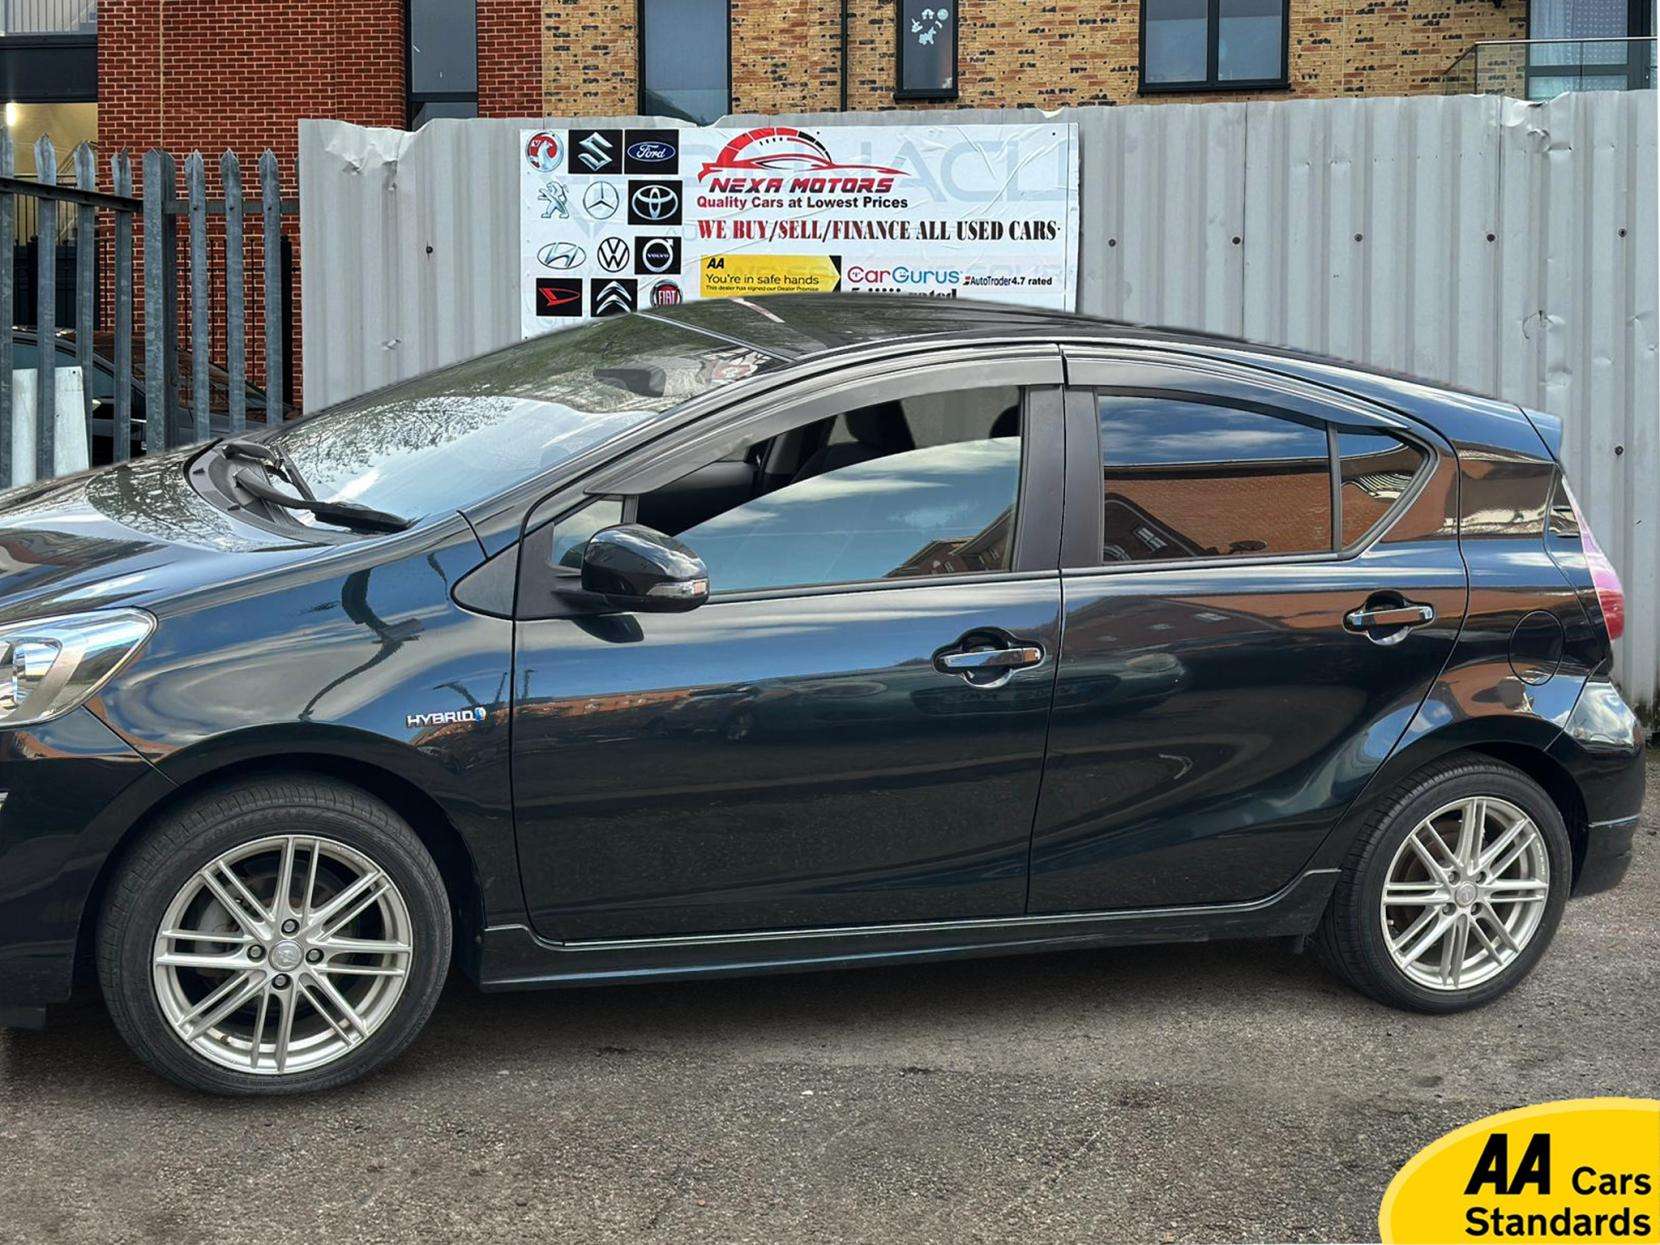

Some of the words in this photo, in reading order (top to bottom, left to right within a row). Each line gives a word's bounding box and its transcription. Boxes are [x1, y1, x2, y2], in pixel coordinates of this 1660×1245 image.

[636, 144, 666, 158] Ford
[709, 178, 783, 193] NEXA
[789, 178, 895, 193] MOTORS
[697, 196, 747, 210] Quality
[752, 196, 783, 208] Cars
[788, 197, 802, 208] at
[807, 197, 858, 208] Lowest
[863, 197, 908, 209] Prices
[698, 220, 726, 239] WE
[916, 221, 950, 240] ALL
[956, 221, 1004, 240] USED
[1008, 220, 1057, 241] CARS
[707, 258, 725, 269] AA
[706, 274, 741, 285] You're
[744, 274, 754, 284] in
[757, 274, 781, 285] safe
[784, 275, 820, 285] hands
[847, 266, 960, 283] CarGurus
[1011, 277, 1026, 286] 4.7
[1028, 277, 1053, 286] rated
[658, 290, 676, 306] FIAT
[407, 710, 475, 727] HYBRID
